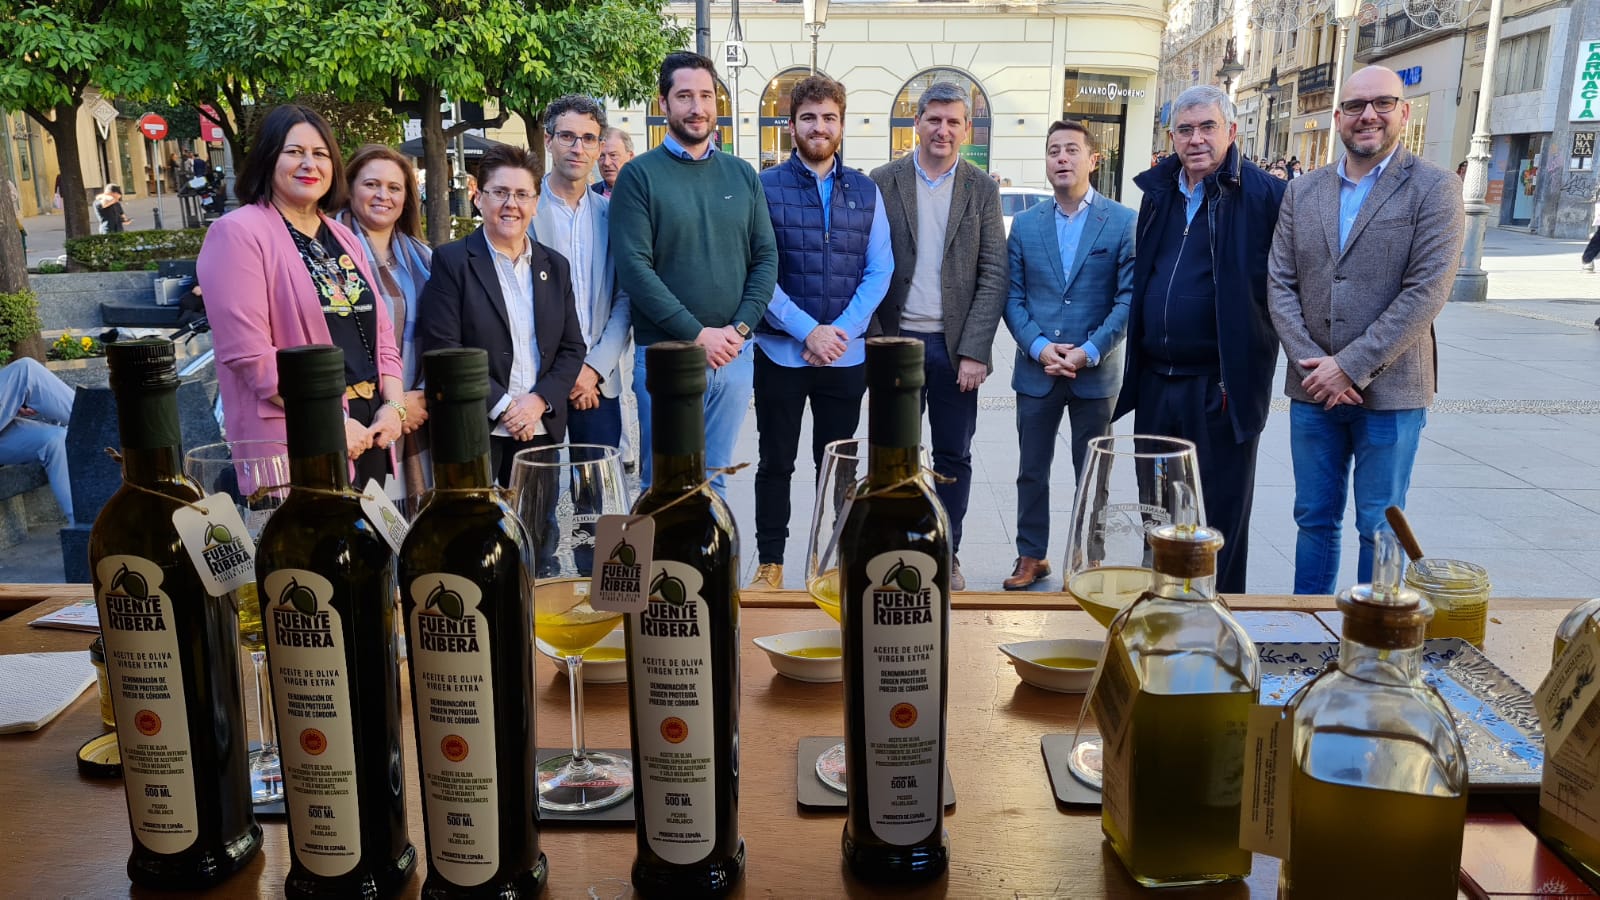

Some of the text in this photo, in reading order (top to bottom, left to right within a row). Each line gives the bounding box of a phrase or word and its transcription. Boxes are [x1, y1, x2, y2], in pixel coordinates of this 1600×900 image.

[1579, 43, 1600, 118] FARMACIA
[1080, 86, 1145, 98] ALVARO MORENO
[1575, 140, 1590, 148] MA
[203, 538, 245, 560] FUENTE
[207, 550, 251, 576] RIBERA
[603, 565, 641, 578] FUENTE
[601, 578, 640, 593] RIBERA
[106, 597, 162, 613] FUENTE
[873, 591, 931, 608] FUENTE
[109, 612, 166, 631] RIBERA
[273, 613, 330, 629] FUENTE
[873, 607, 932, 625] RIBERA
[419, 616, 476, 634] FUENTE
[640, 618, 700, 637] RIBERA
[276, 627, 334, 648] RIBERA
[420, 631, 479, 653] RIBERA
[873, 644, 934, 654] ACEITE DE OLIVA
[113, 651, 172, 660] ACEITE DE OLIVA
[878, 654, 930, 663] VIRGEN EXTRA
[119, 661, 168, 669] VIRGEN EXTRA
[643, 657, 666, 666] ACEITE
[280, 667, 339, 677] ACEITE DE OLIVA
[647, 666, 672, 675] VIRGEN
[284, 677, 335, 687] VIRGEN EXTRA
[423, 672, 483, 683] ACEITE DE OLIVA
[427, 682, 479, 692] VIRGEN EXTRA
[891, 780, 918, 789] 500 ML
[145, 788, 172, 797] 500 ML
[665, 796, 692, 806] 500 ML
[308, 809, 336, 819] 500 ML
[447, 816, 474, 827] 500 ML
